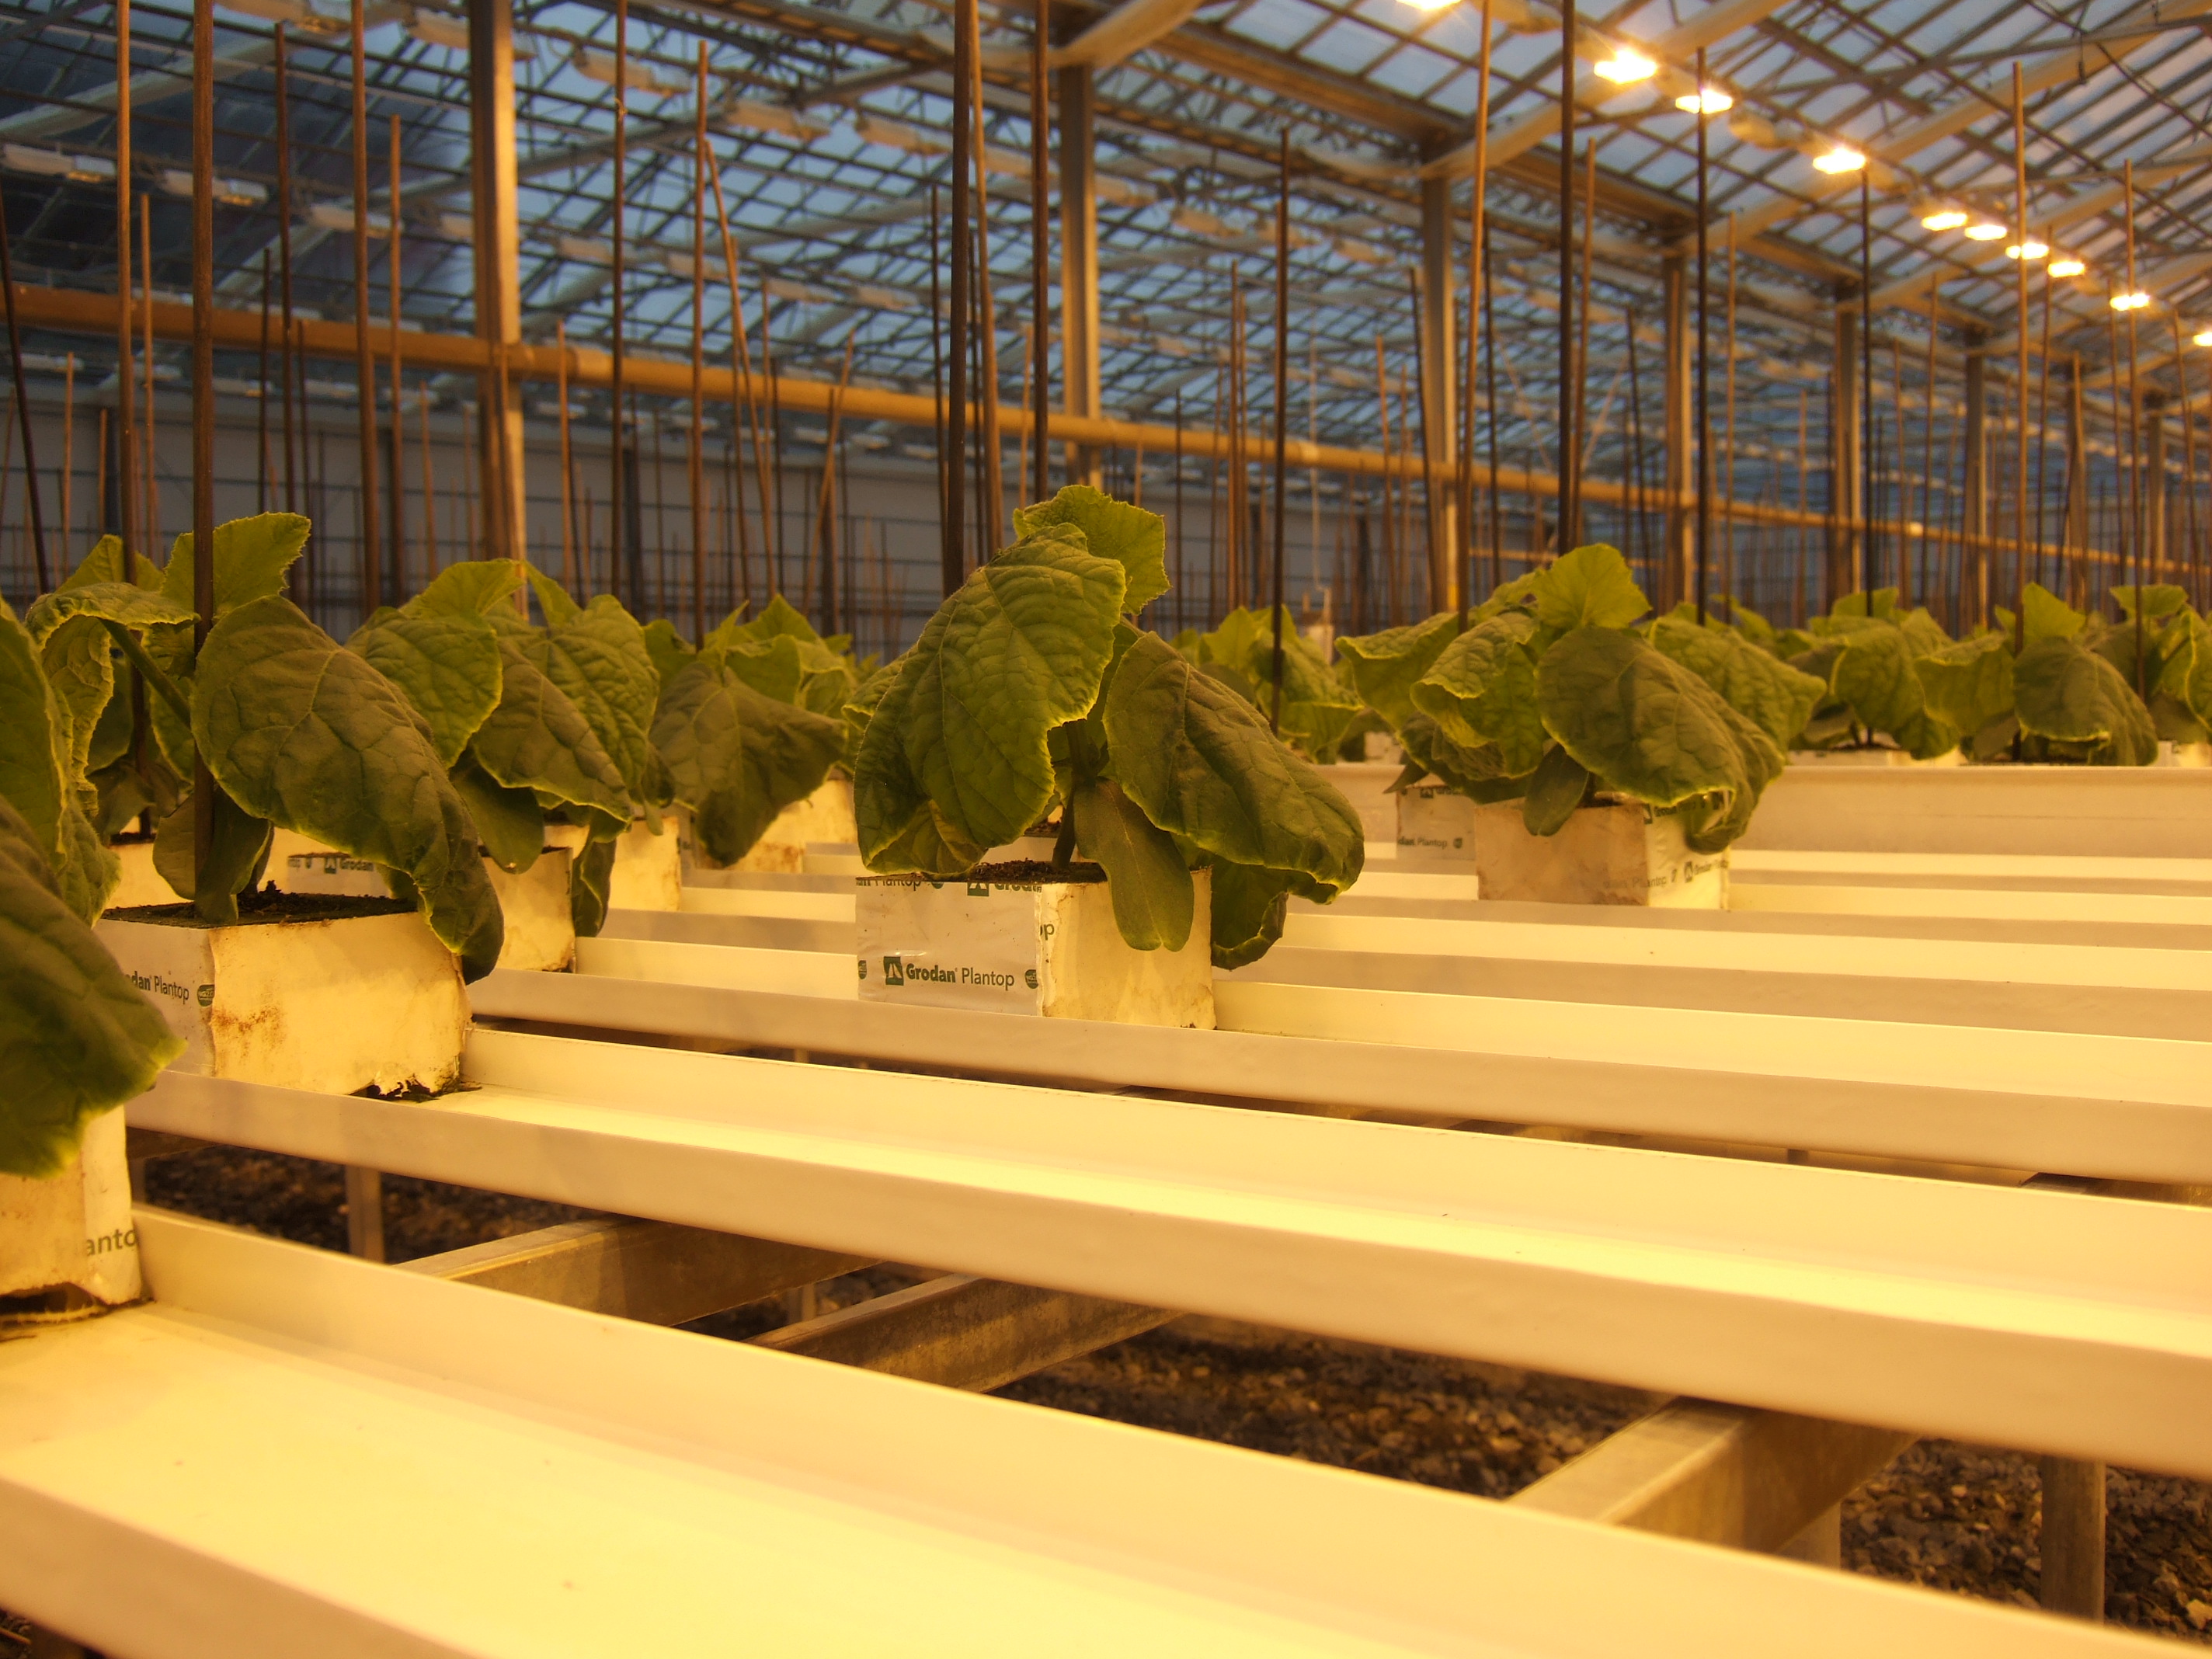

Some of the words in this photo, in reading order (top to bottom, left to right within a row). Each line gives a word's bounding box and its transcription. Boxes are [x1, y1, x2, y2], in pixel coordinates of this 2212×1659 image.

[154, 976, 190, 1004] Plantop
[906, 963, 956, 983] Grodan
[962, 967, 1014, 991] Plantop
